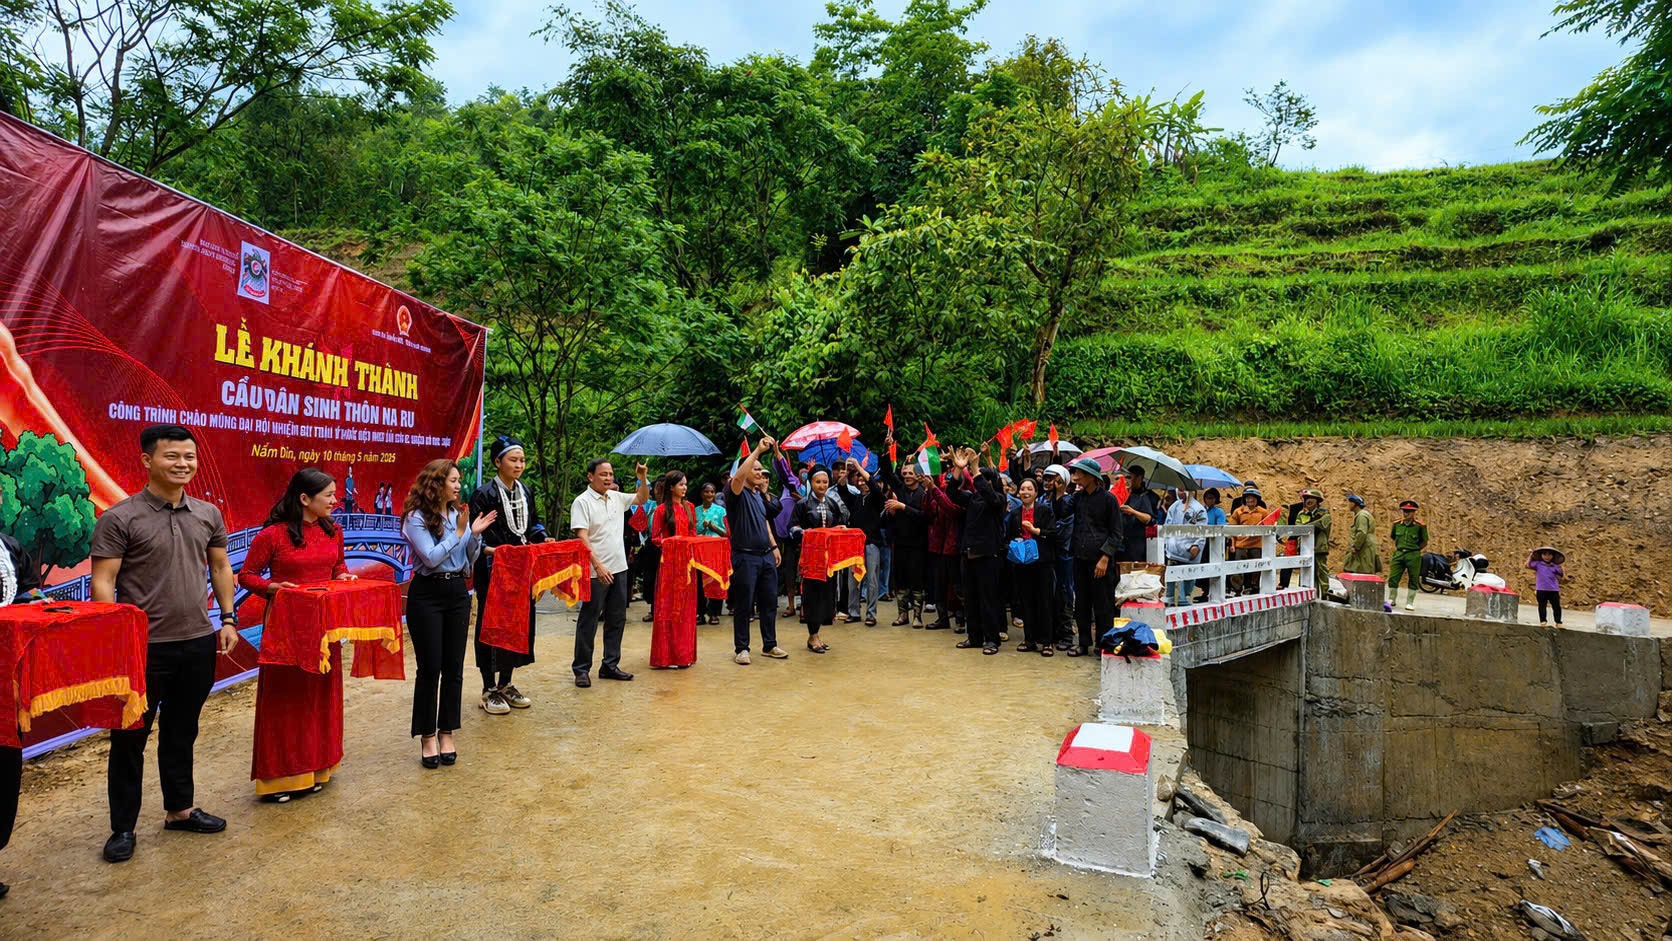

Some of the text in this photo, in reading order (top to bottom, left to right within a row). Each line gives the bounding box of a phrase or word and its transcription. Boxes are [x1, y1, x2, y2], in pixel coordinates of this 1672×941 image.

[259, 336, 349, 388] KHÁNH
[109, 400, 141, 421] CÔNG
[144, 405, 176, 424] TRÌNH
[180, 409, 207, 427] CHÀO
[304, 396, 340, 420] SINH
[344, 400, 379, 425] THÔN
[382, 407, 398, 427] NA
[400, 410, 415, 428] RU
[298, 449, 321, 463] ngày
[323, 450, 332, 461] 10
[333, 450, 356, 464] tháng
[357, 452, 362, 462] 5
